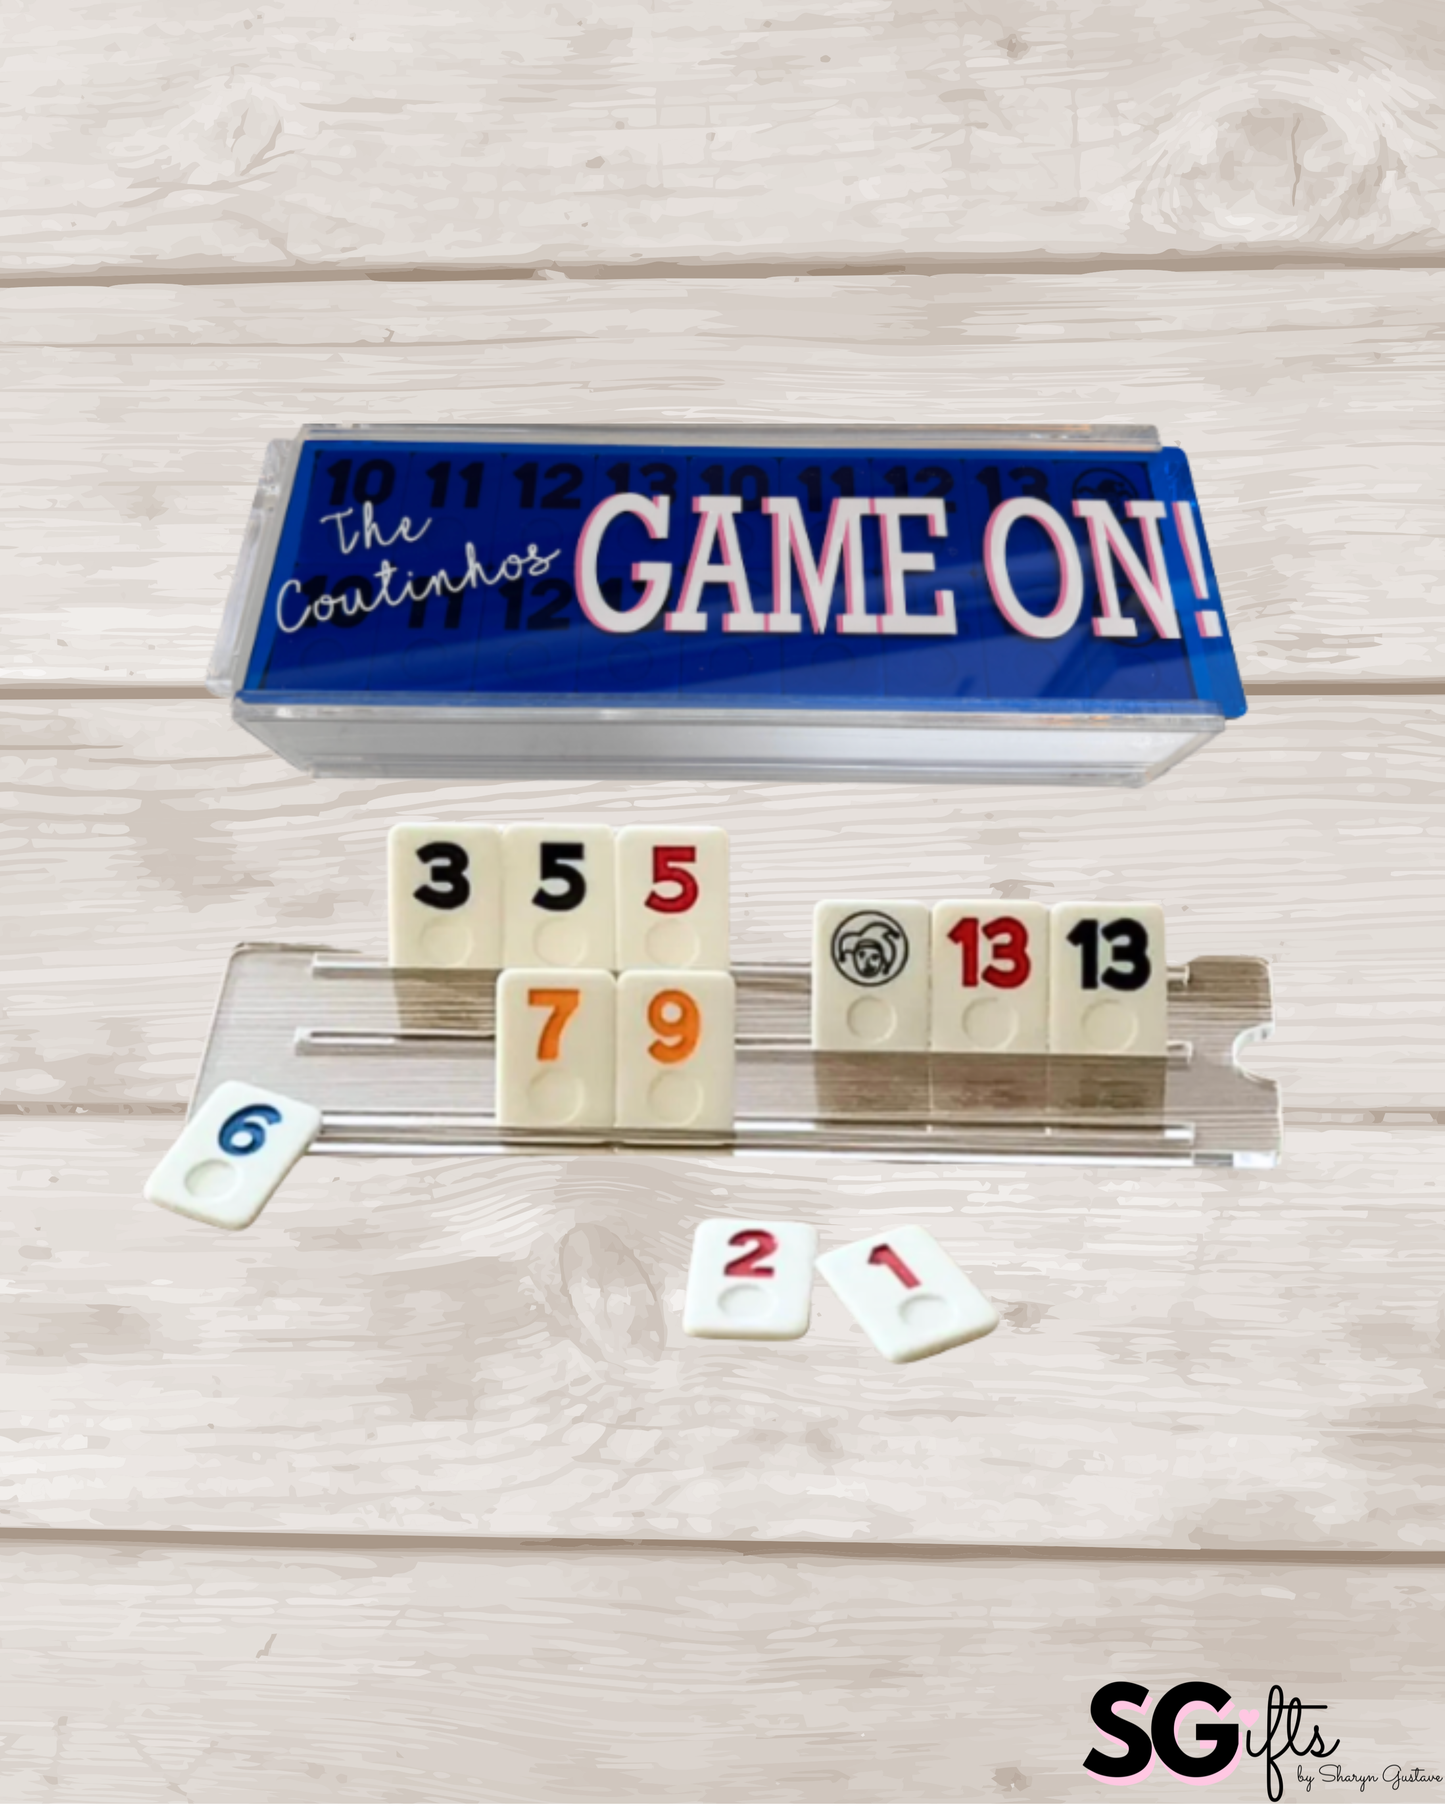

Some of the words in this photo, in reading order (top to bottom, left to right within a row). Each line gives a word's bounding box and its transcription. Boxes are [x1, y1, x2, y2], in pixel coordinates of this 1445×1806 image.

[425, 461, 485, 509] 11
[513, 462, 585, 510] 12
[320, 500, 432, 555] The
[276, 542, 561, 633] Coutinhos
[574, 492, 958, 634] GAME
[983, 496, 1223, 640] ON!
[413, 842, 470, 910] 3
[531, 842, 587, 911] 5
[644, 845, 700, 914] 5
[947, 916, 1032, 990] 13
[1065, 917, 1152, 992] 13
[527, 988, 581, 1062] 7
[647, 989, 702, 1064] 9
[217, 1103, 283, 1157] 6
[723, 1229, 779, 1278] 2
[867, 1243, 922, 1290] 1
